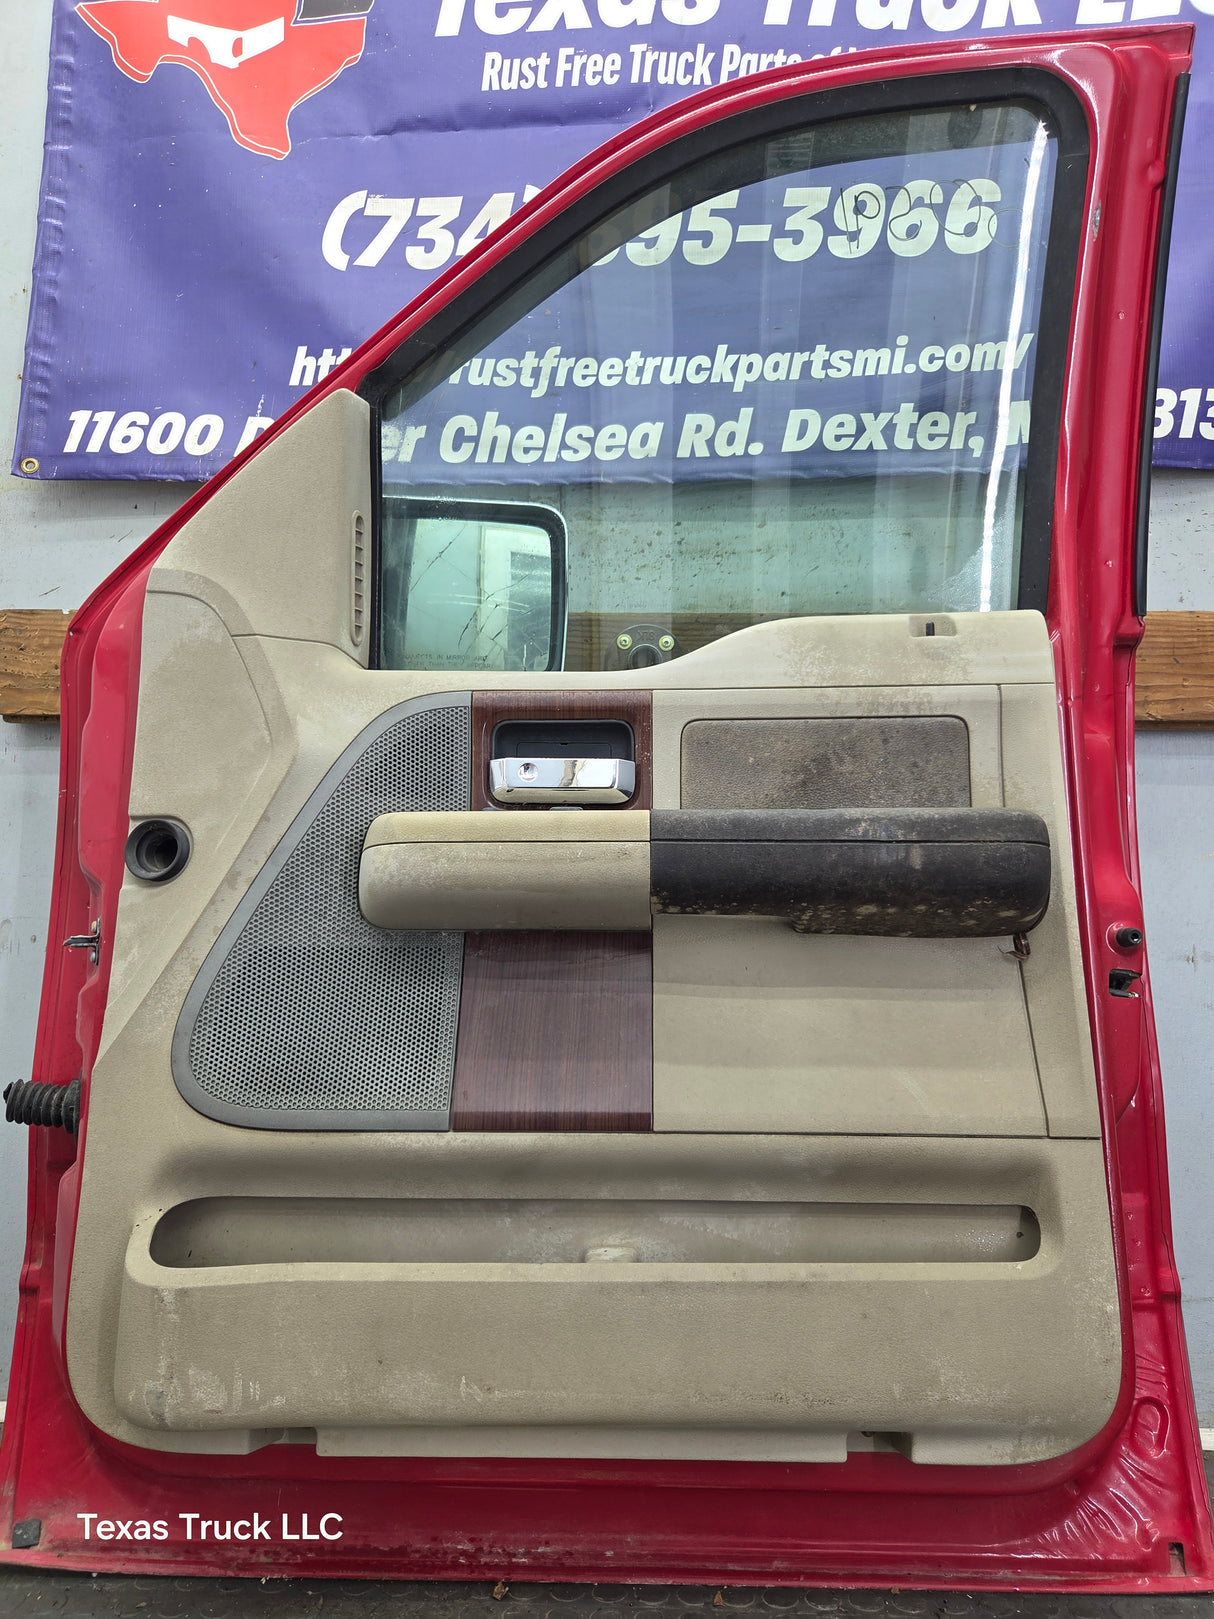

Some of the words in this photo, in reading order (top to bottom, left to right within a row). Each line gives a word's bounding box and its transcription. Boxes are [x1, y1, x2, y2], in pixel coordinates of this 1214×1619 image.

[481, 52, 550, 91] Rust
[555, 47, 621, 88] Free
[630, 43, 715, 86] Truck
[592, 178, 1002, 267] 95-3966
[62, 410, 224, 456] 11600
[439, 411, 664, 463] Chelsea
[676, 407, 764, 459] Rd.
[781, 402, 985, 458] Dexter,
